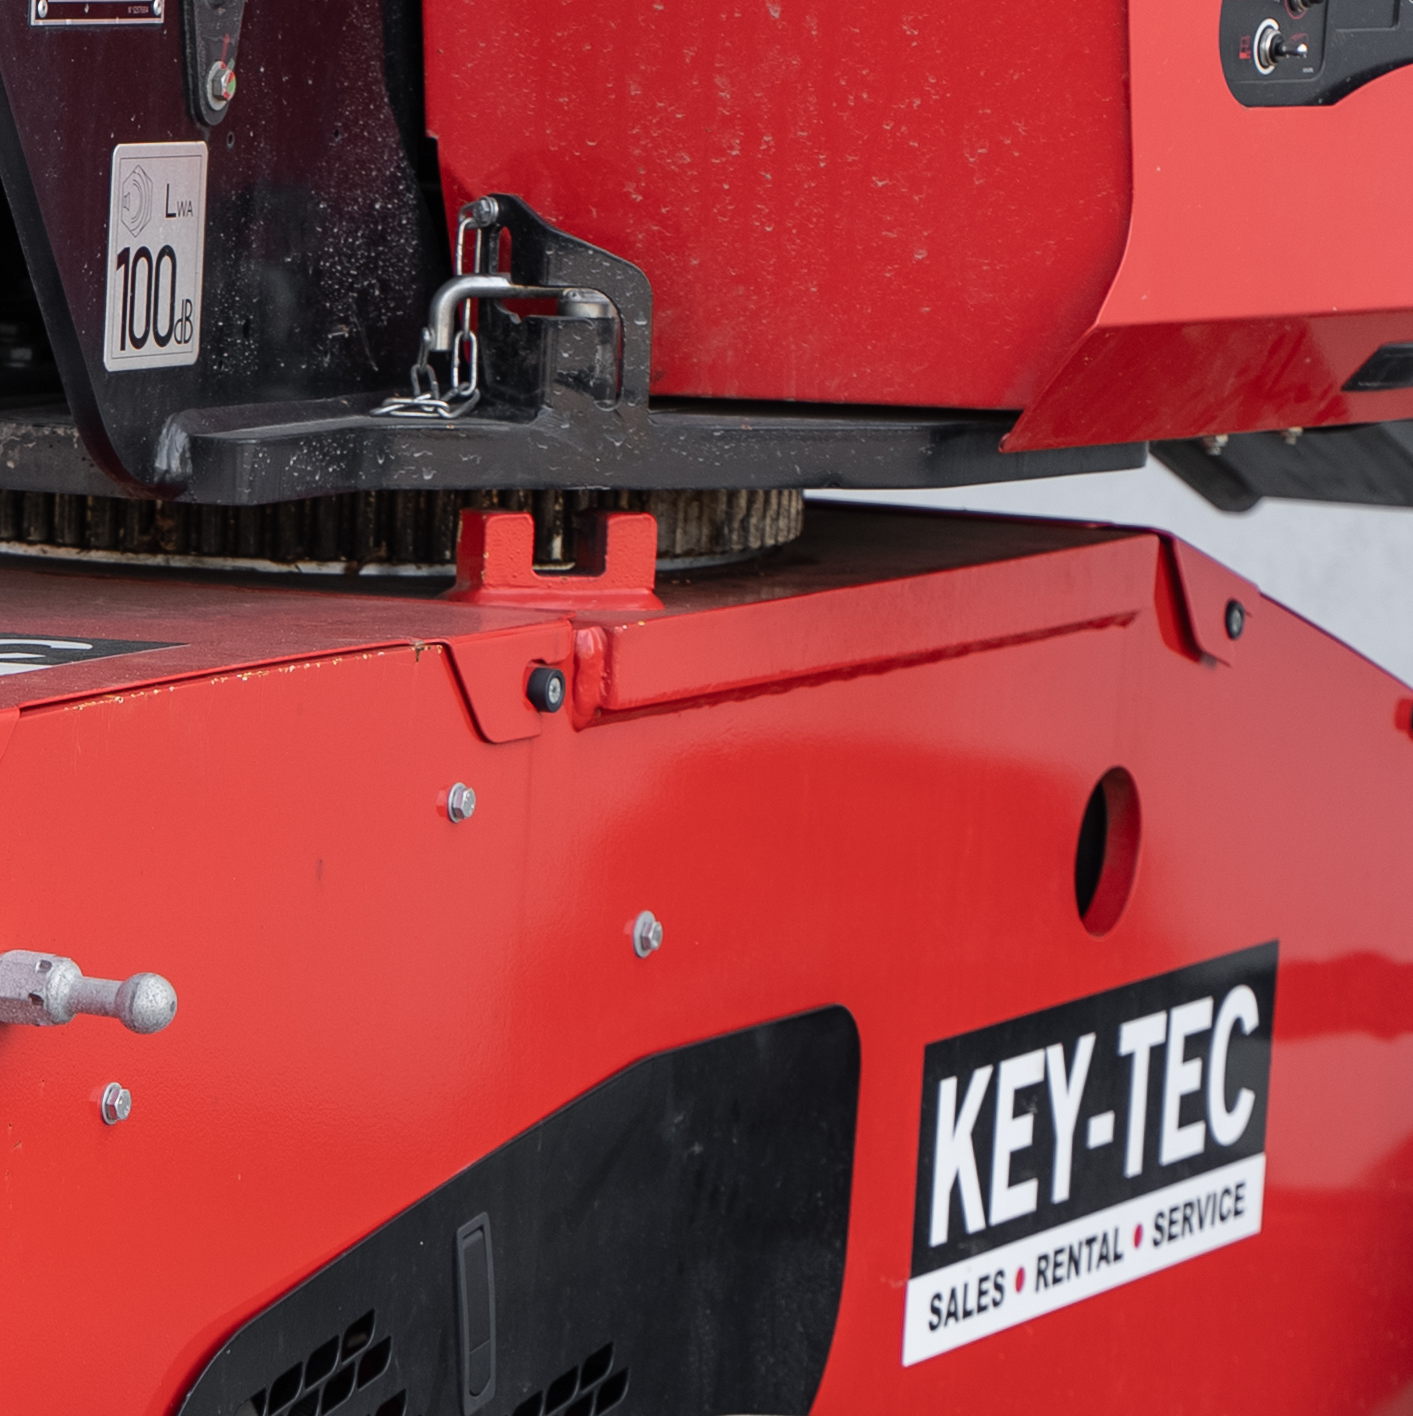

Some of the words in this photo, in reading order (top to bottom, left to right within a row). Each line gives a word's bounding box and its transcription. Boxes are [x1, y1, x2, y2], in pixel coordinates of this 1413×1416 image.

[116, 244, 178, 352] 100
[173, 298, 194, 345] dB
[929, 984, 1260, 1248] KEY-TEC
[928, 1269, 1006, 1332] SALES
[1035, 1227, 1124, 1293] RENTAL
[1152, 1181, 1246, 1248] SERVICE
